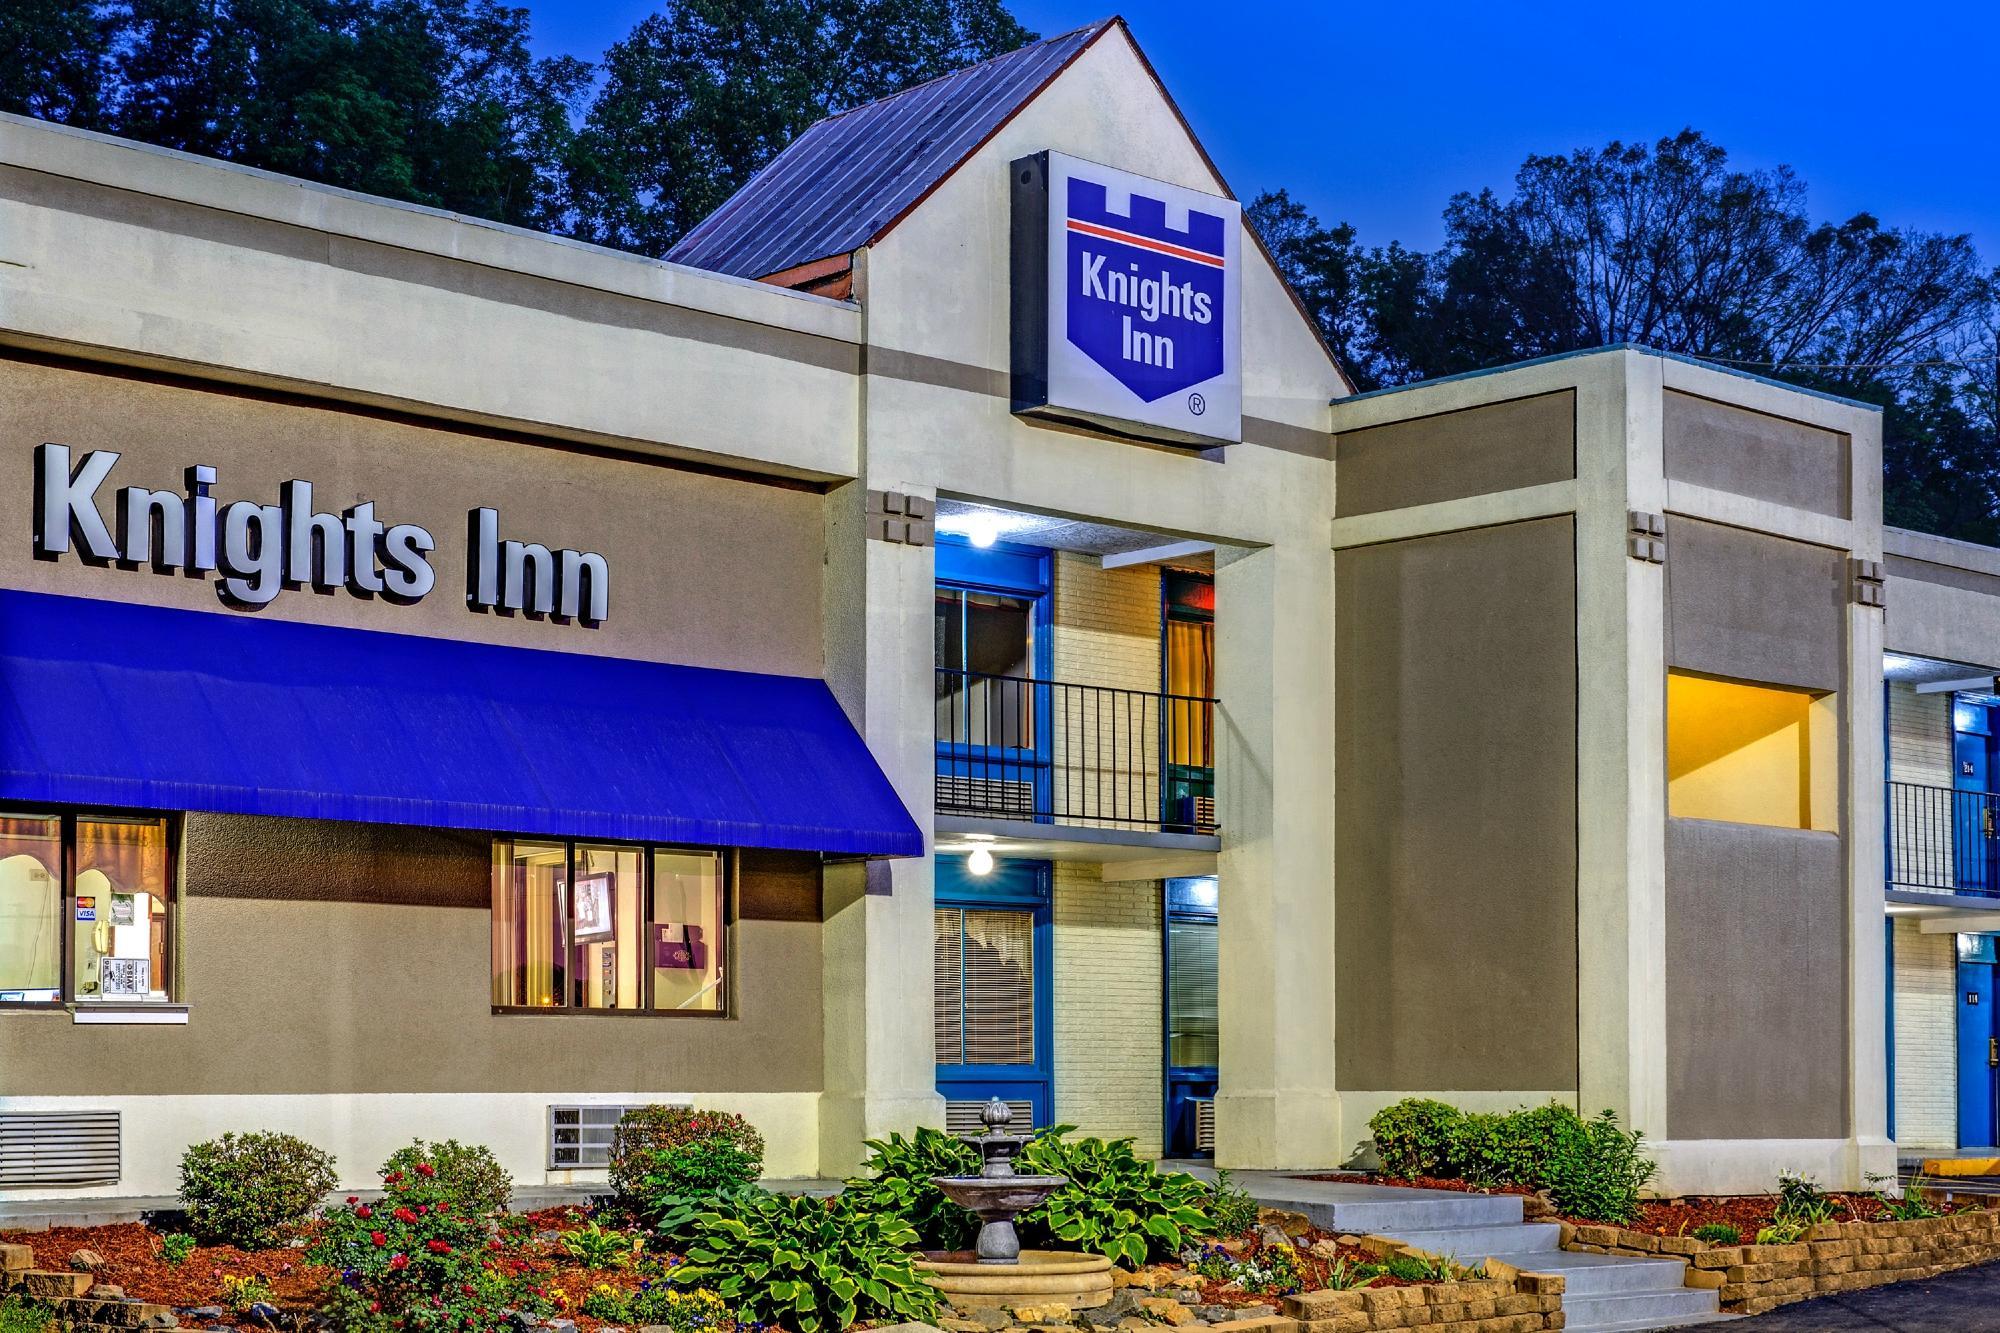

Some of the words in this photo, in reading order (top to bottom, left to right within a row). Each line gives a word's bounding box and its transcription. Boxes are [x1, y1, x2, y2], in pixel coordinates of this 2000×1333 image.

[1082, 251, 1212, 324] Knights
[1122, 315, 1174, 369] Inn
[40, 442, 436, 604] Knights
[474, 507, 610, 623] Inn
